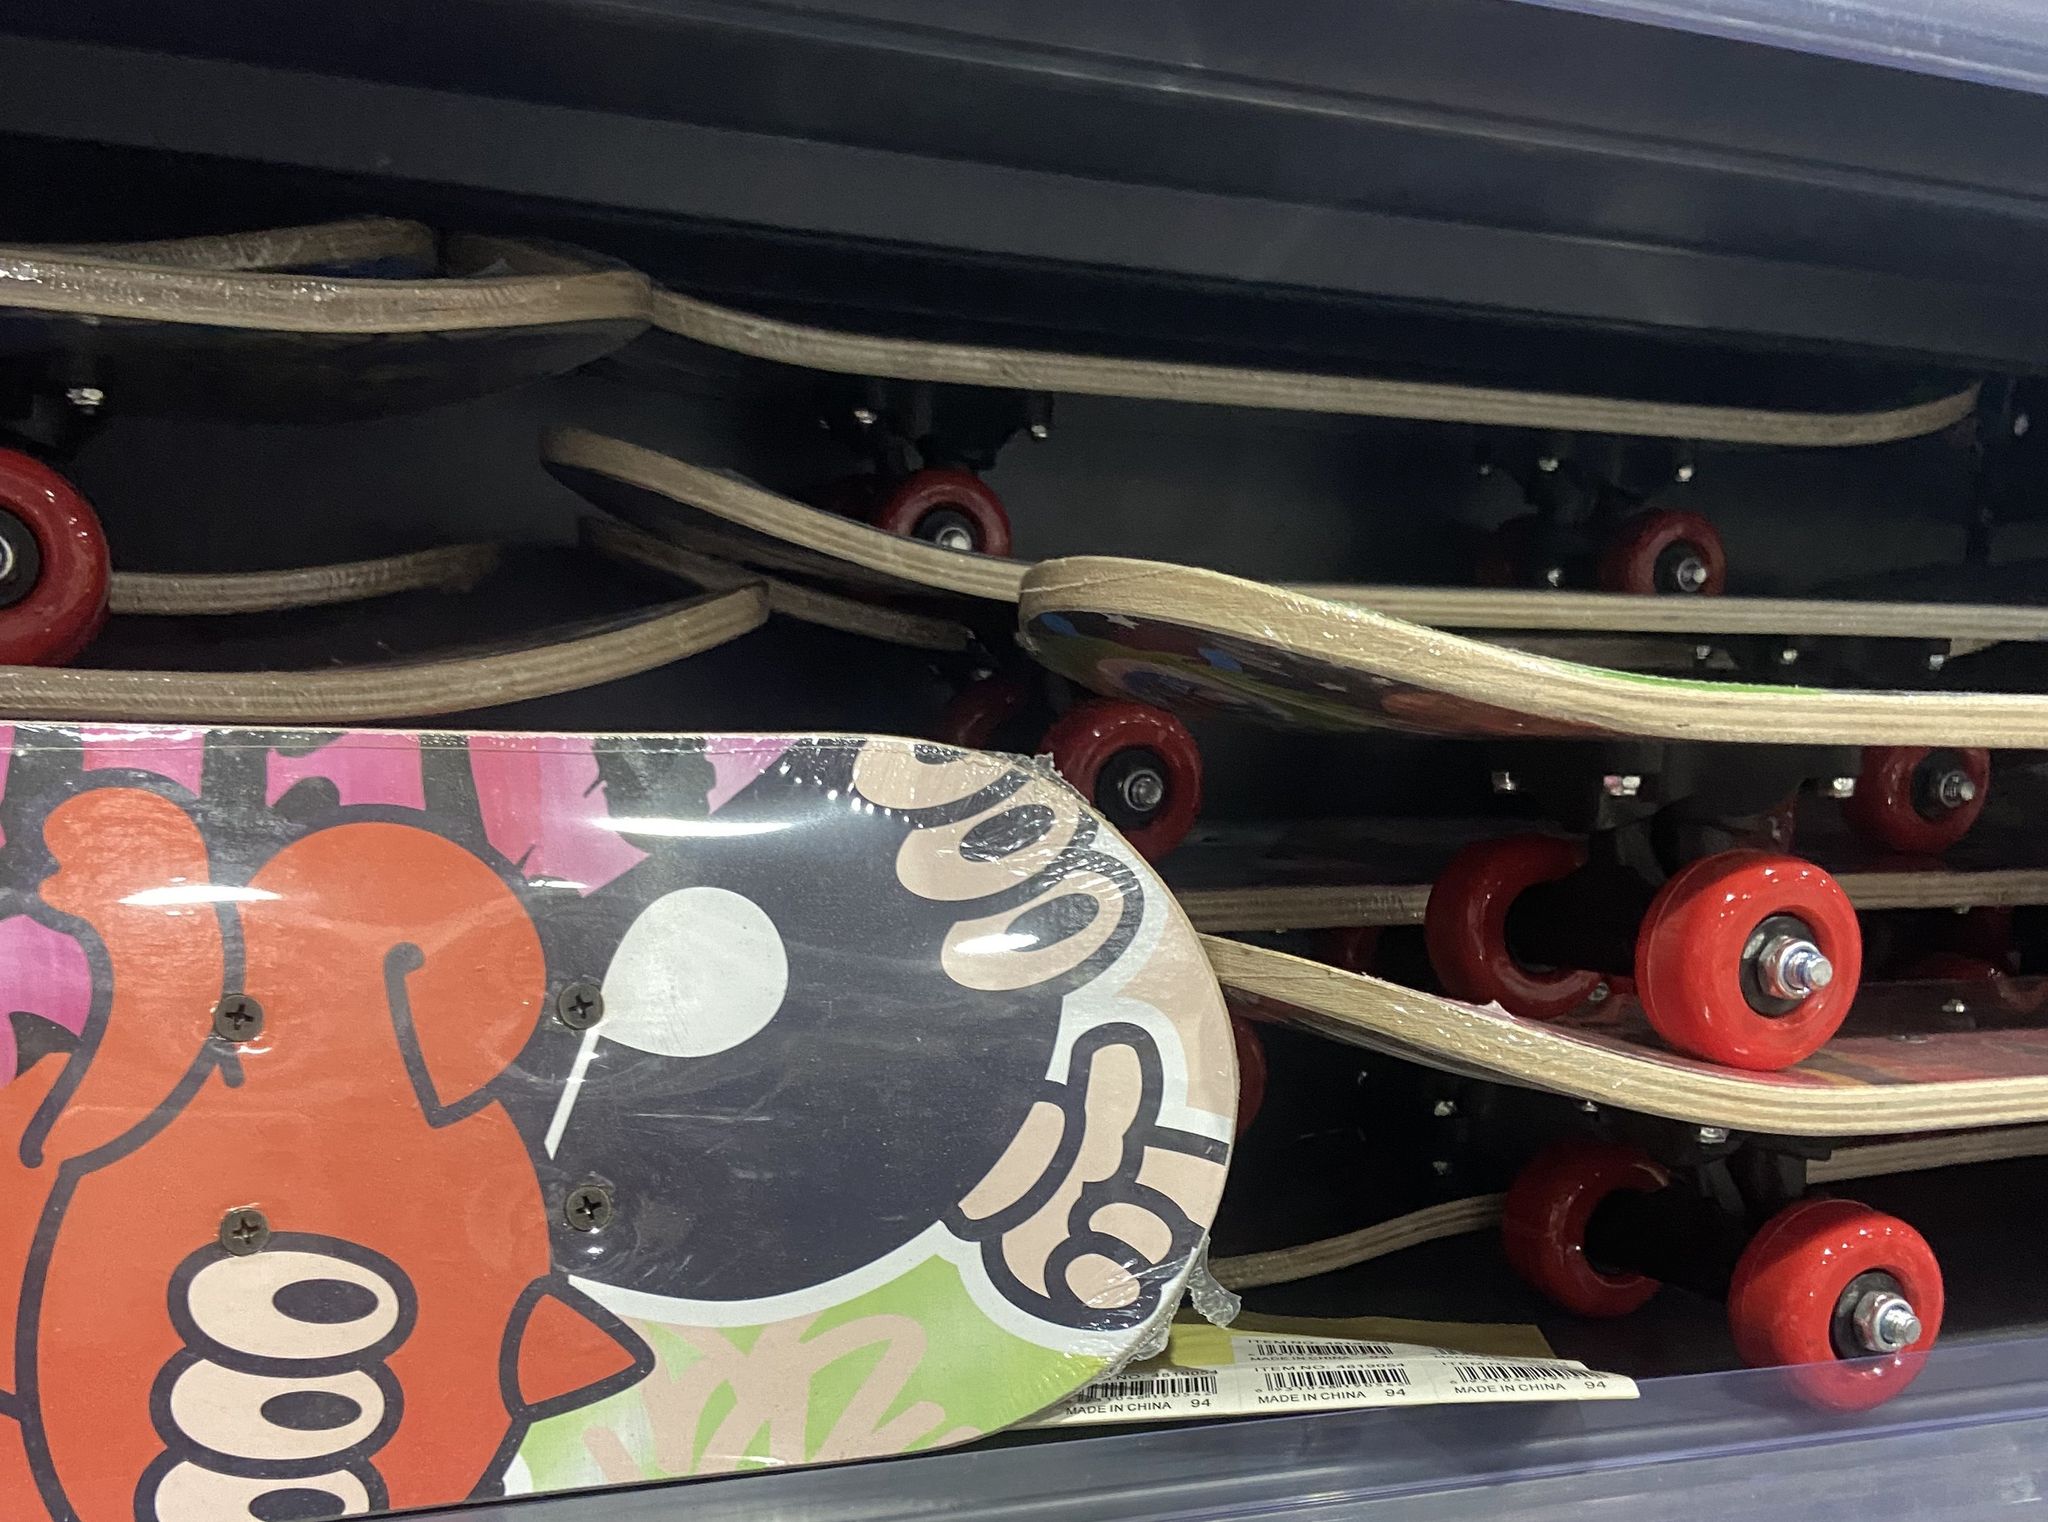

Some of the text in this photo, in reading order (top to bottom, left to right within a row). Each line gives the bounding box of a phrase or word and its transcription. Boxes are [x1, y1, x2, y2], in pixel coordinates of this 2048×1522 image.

[1116, 1373, 1146, 1381] NO:
[1454, 1380, 1607, 1394] MADE IN CHINA 94
[1258, 1388, 1406, 1404] MADE IN CHINA 94
[1066, 1398, 1211, 1416] MADE IN CHINA 94
